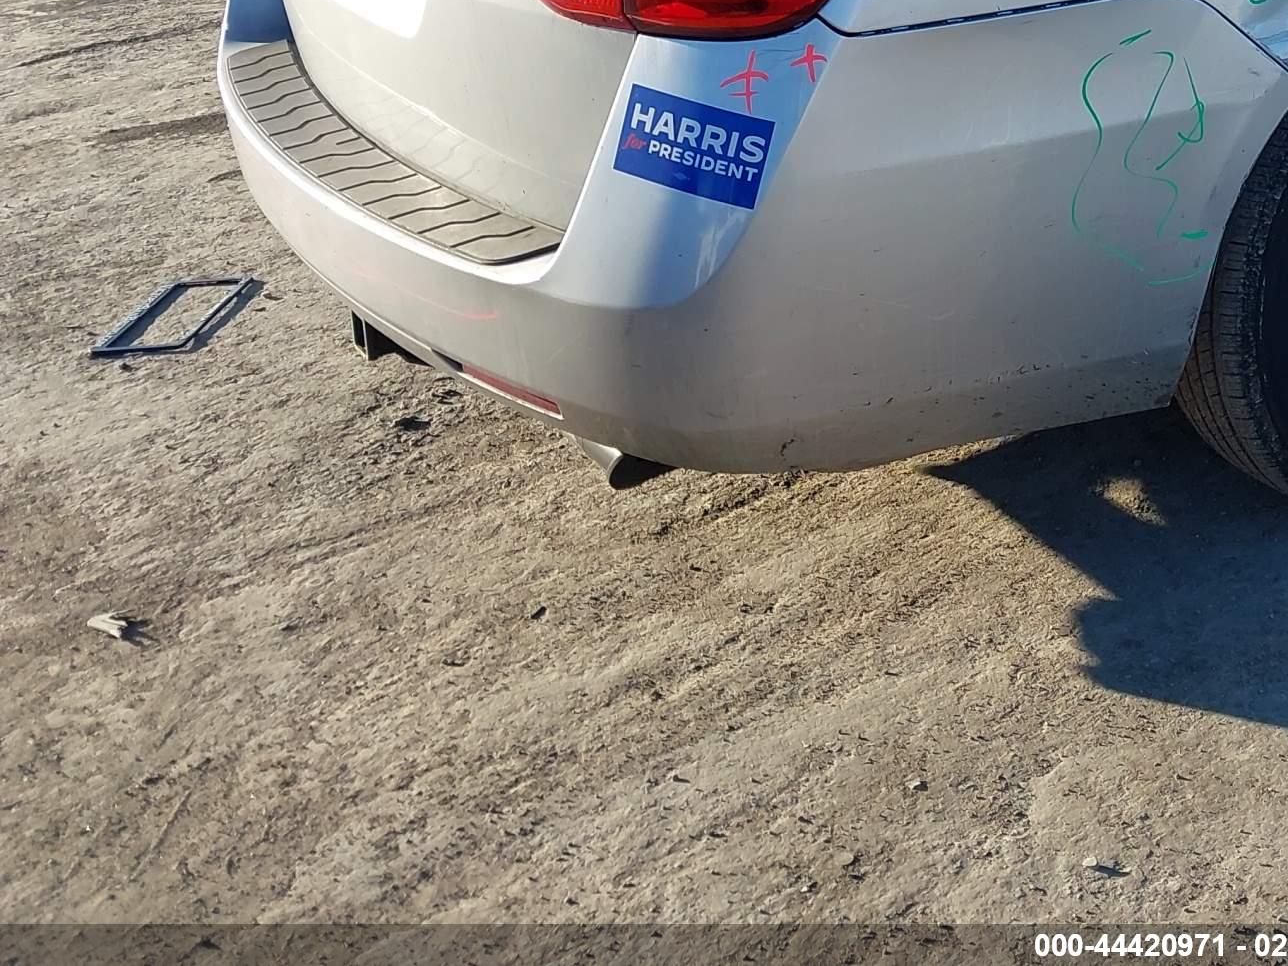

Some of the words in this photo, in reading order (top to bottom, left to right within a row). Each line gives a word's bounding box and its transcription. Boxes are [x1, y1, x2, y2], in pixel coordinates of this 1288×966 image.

[623, 134, 647, 150] for
[649, 141, 758, 182] PRESIDENT
[631, 104, 766, 163] HARRIS
